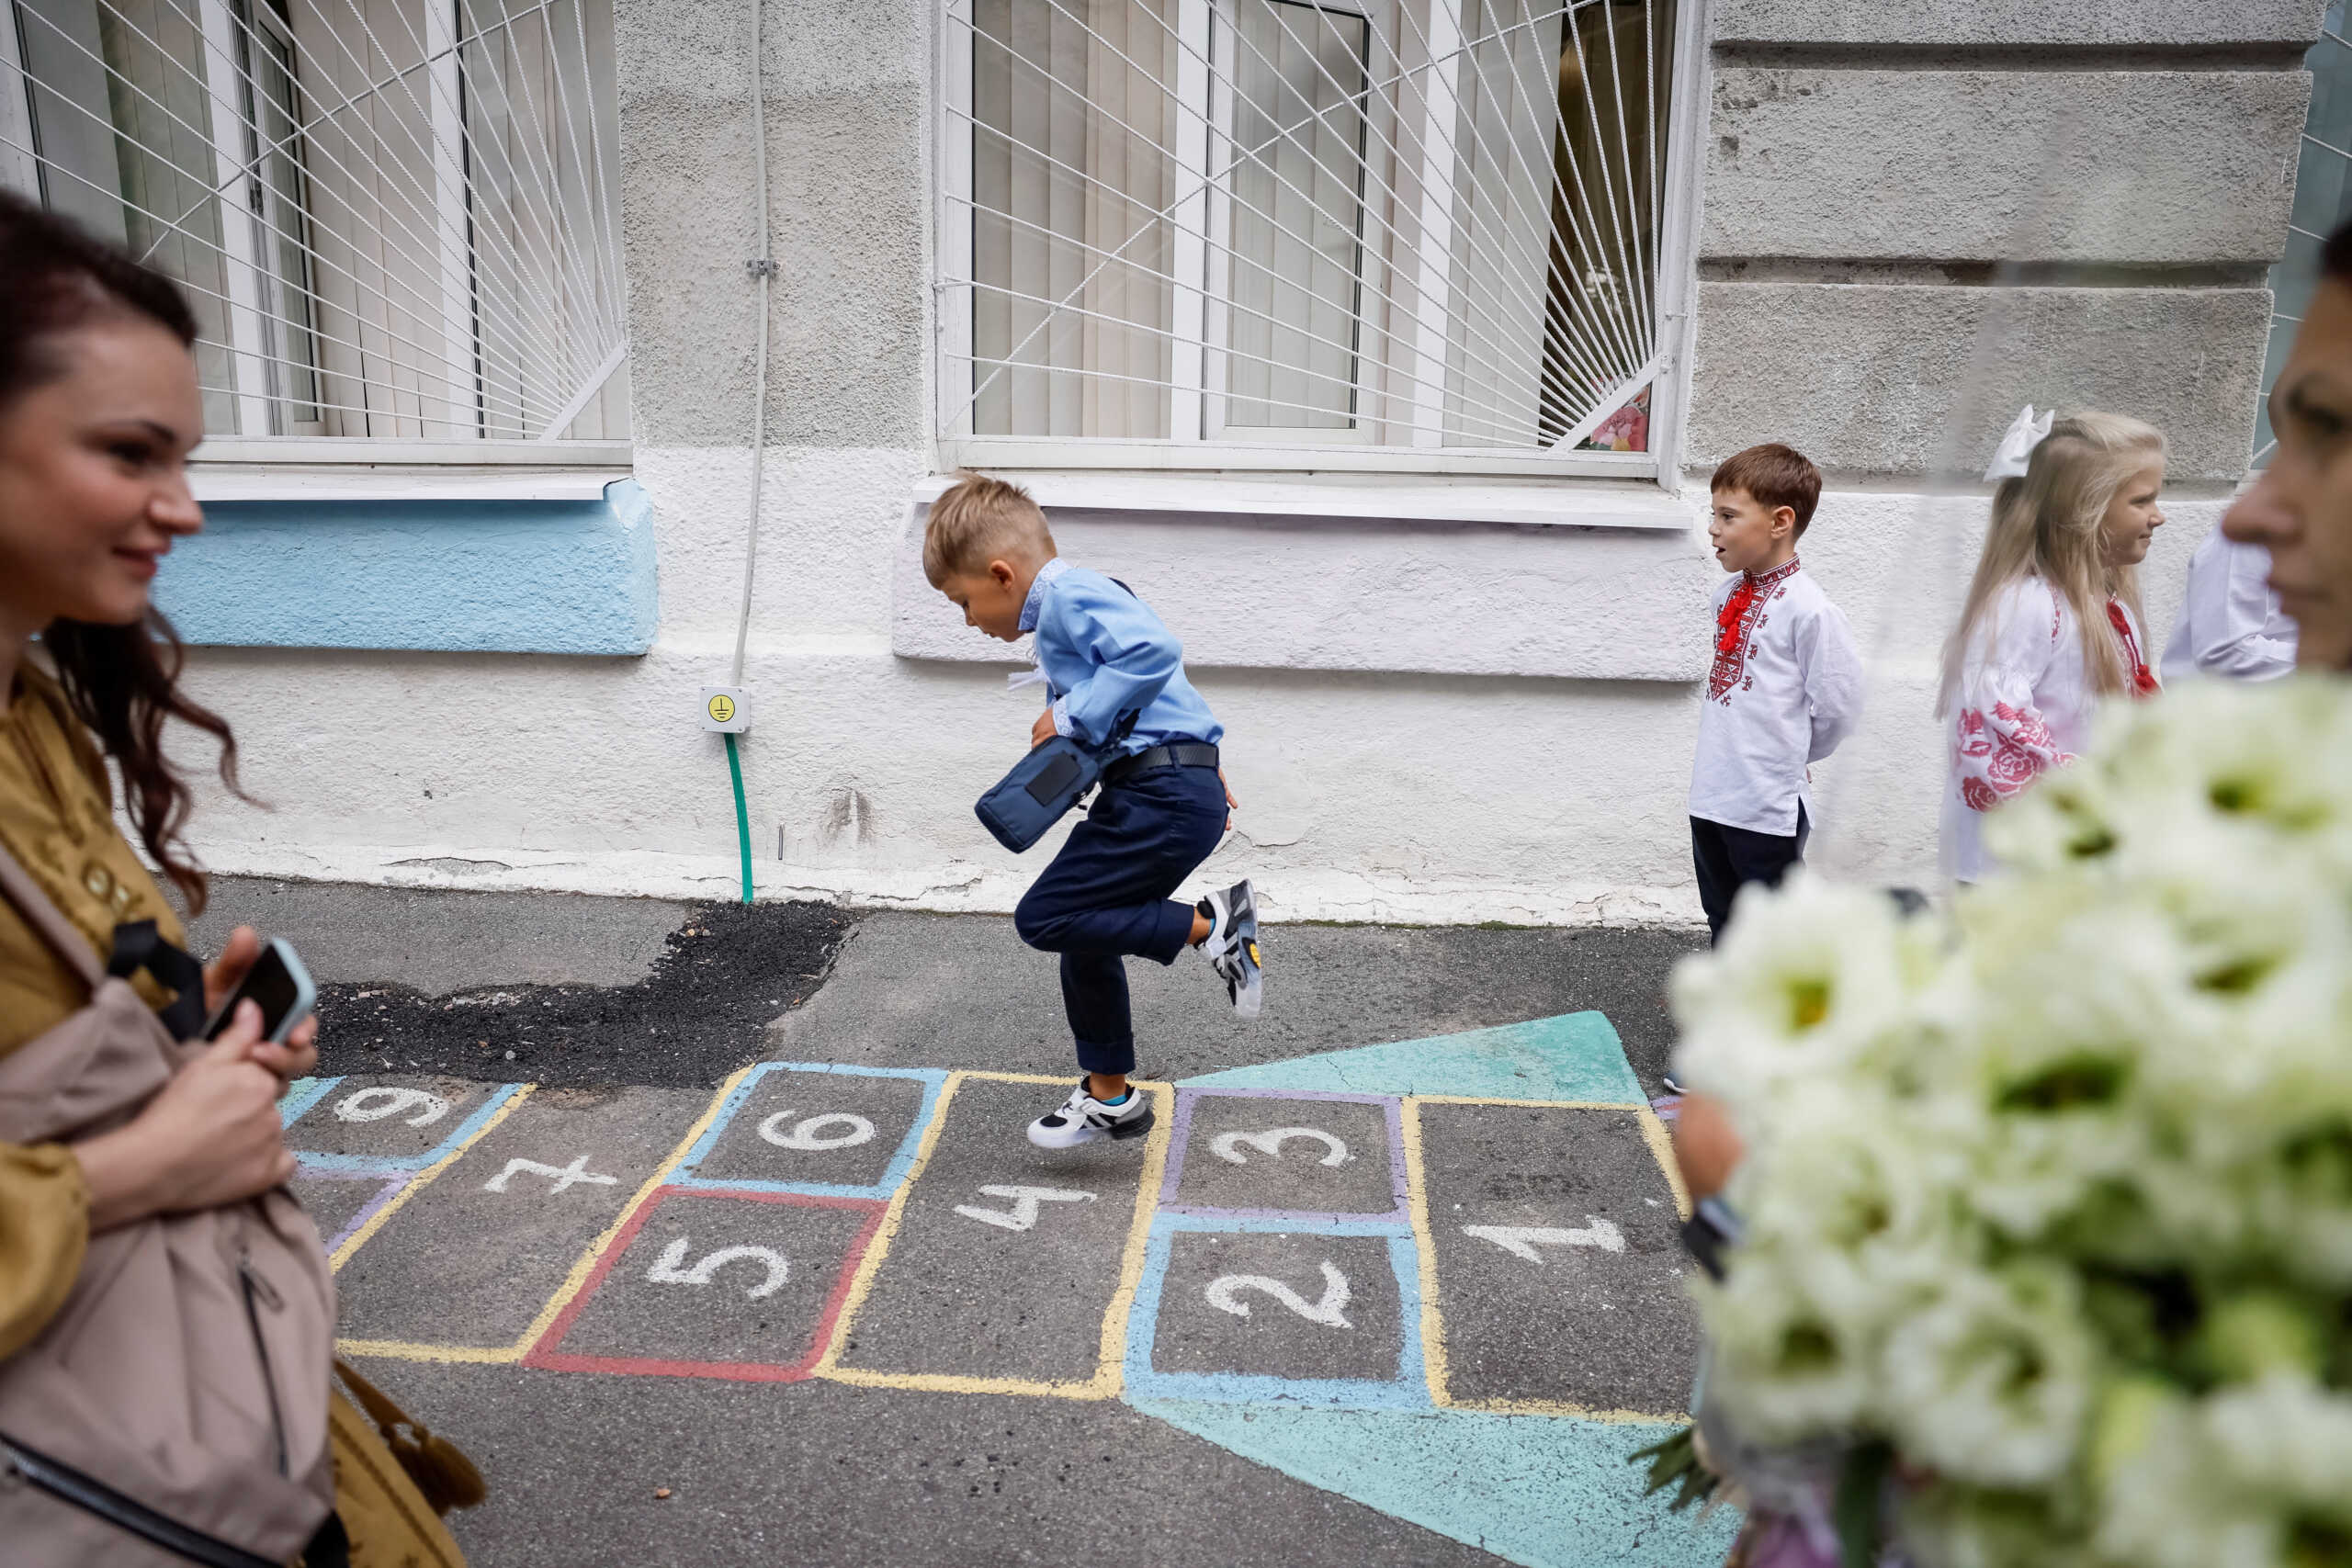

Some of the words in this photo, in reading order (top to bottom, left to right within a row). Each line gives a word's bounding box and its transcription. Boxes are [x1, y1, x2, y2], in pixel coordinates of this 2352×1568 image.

[334, 1088, 449, 1127] 9
[758, 1110, 876, 1150] 6
[1210, 1127, 1352, 1167] 3
[484, 1155, 618, 1193] 7
[955, 1185, 1097, 1232] 4
[1463, 1216, 1623, 1264] 1
[647, 1237, 789, 1298] 5
[1204, 1260, 1351, 1327] 2
